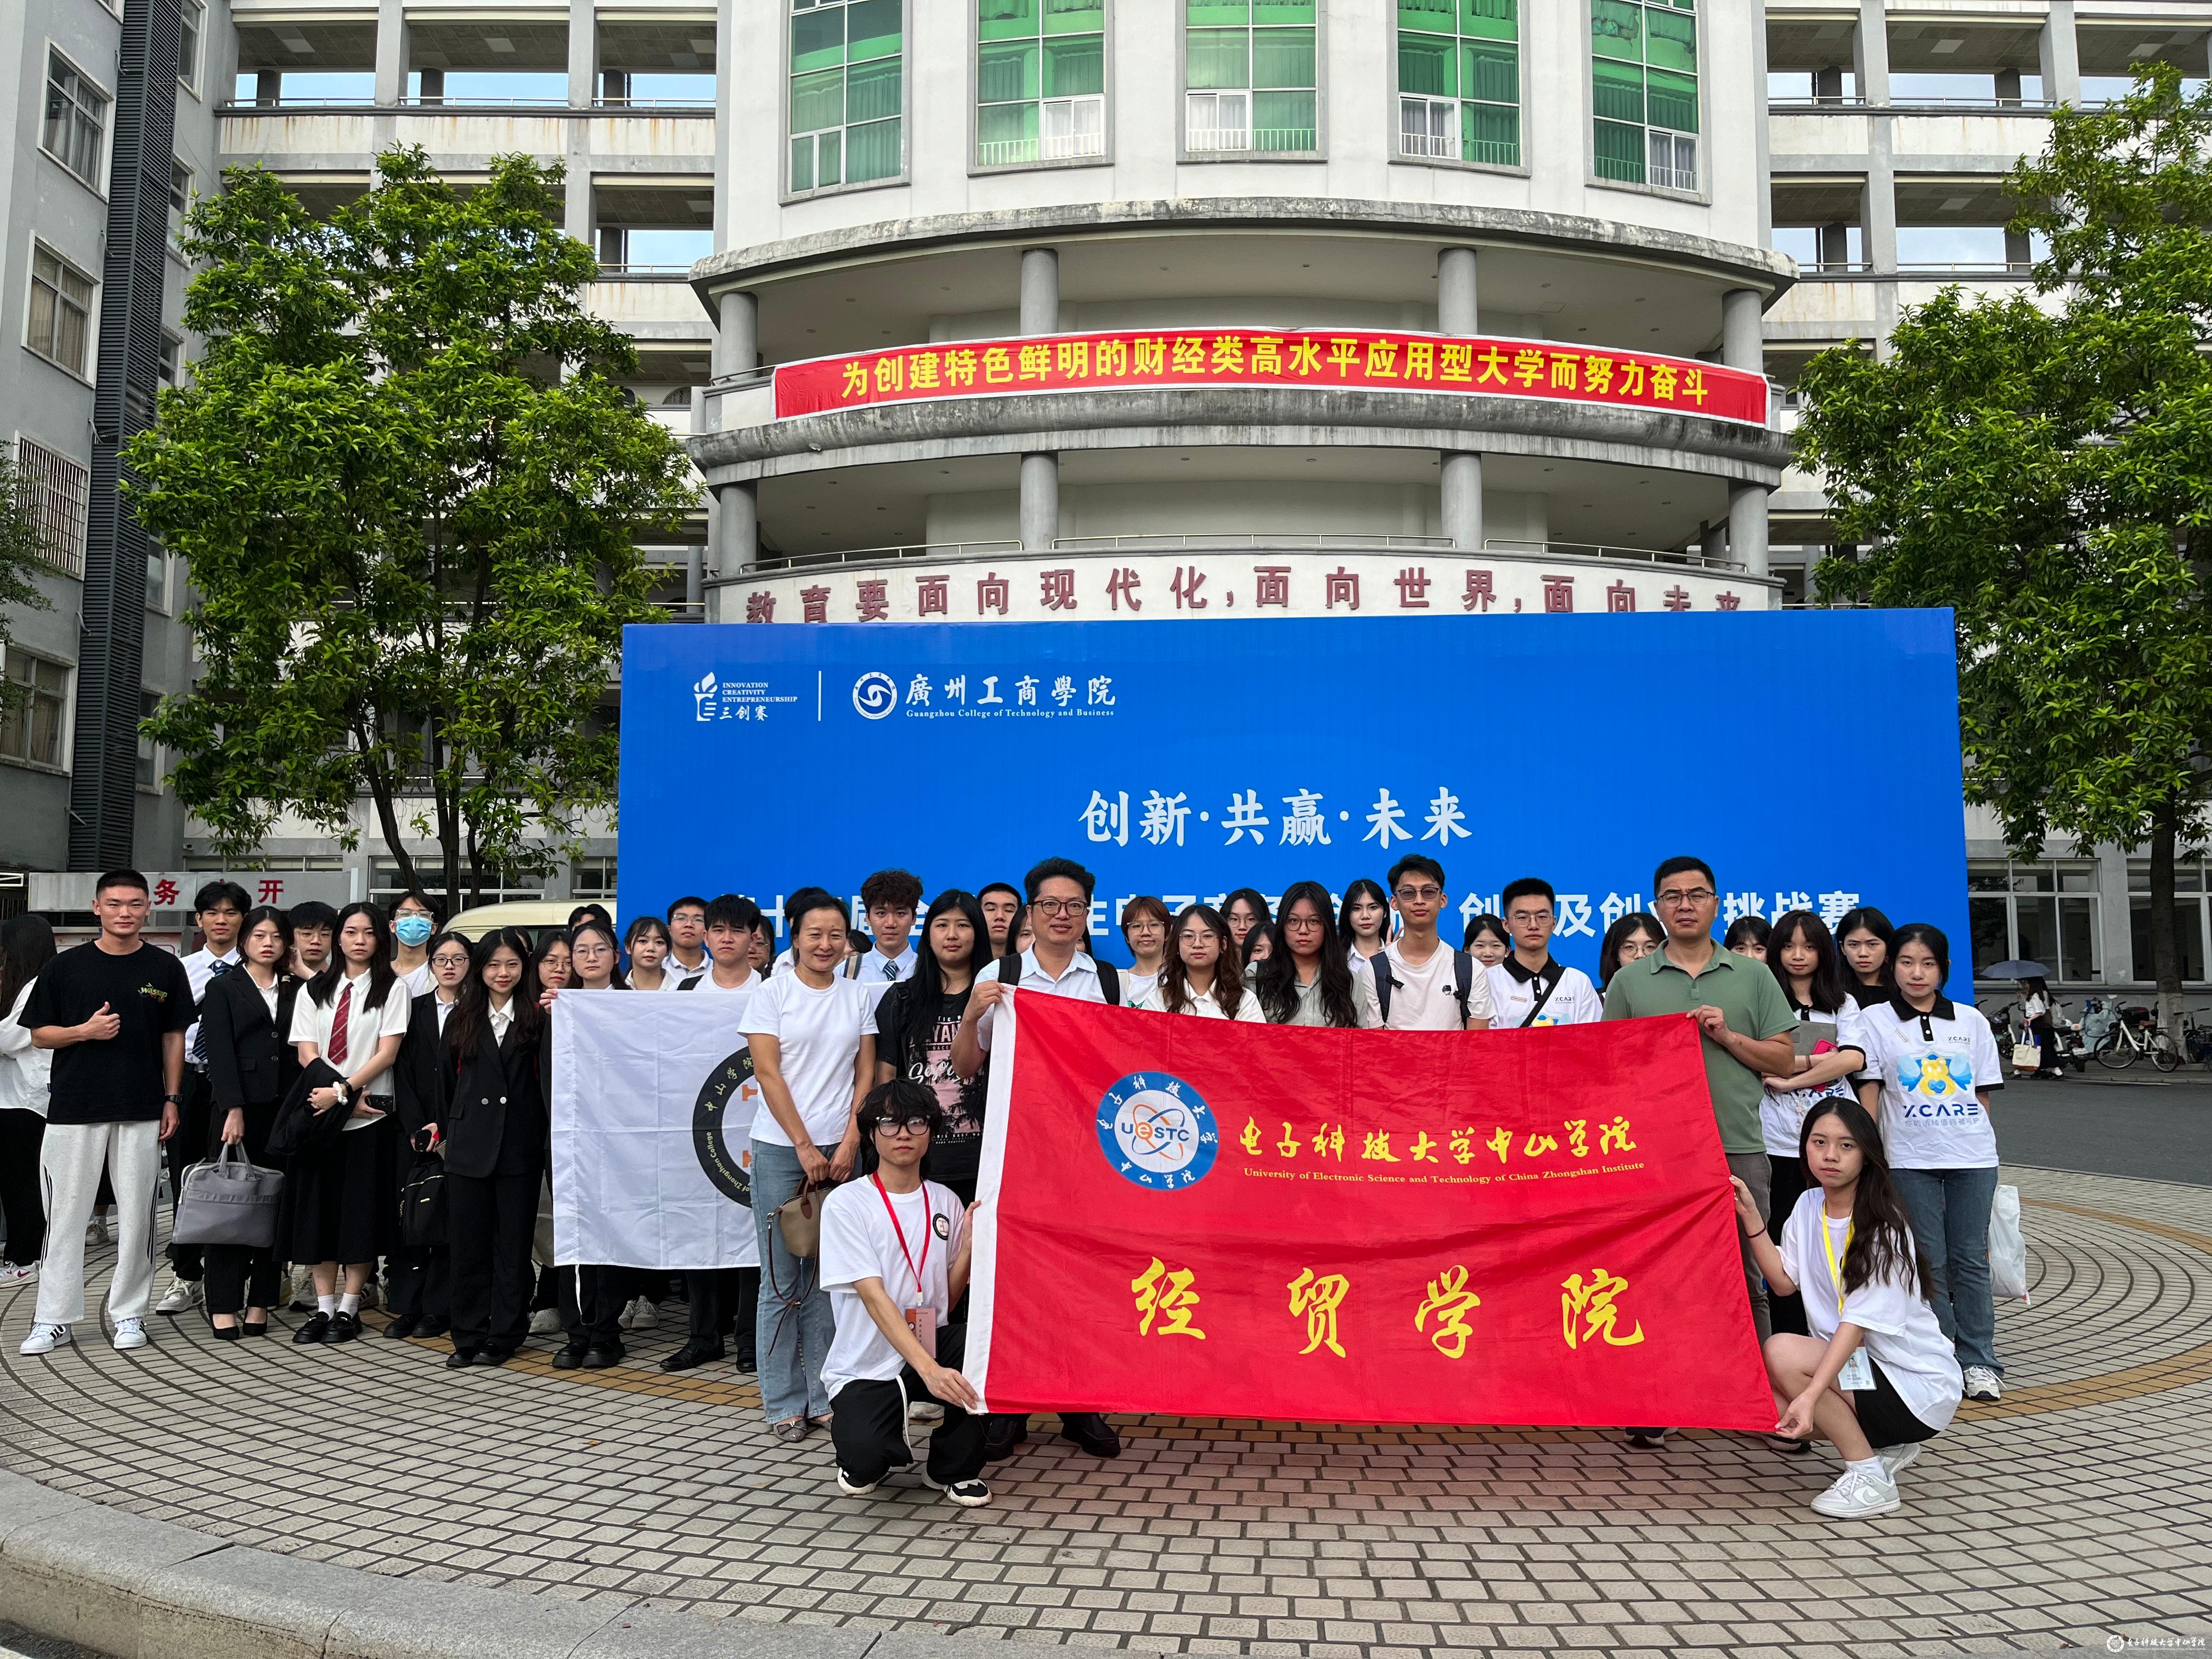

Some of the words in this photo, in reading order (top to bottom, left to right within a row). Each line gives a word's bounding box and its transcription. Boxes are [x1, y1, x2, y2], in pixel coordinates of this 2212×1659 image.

[842, 336, 1708, 406] 为创建特色鲜明的财经类高水平应用型大学而努力奋斗
[906, 673, 1116, 707] 廣州工商學院
[719, 704, 769, 721] 三创赛
[906, 709, 955, 719] Guangzhou
[958, 709, 990, 719] College
[1005, 709, 1055, 719] Technology
[1078, 786, 1472, 849] 创新·共赢·未来
[706, 1131, 717, 1158] College
[1239, 1115, 1637, 1165] 电子科技大学中山学院
[715, 1158, 742, 1189] Zhongshan
[1244, 1167, 1295, 1181] University
[1299, 1171, 1311, 1180] of
[1313, 1172, 1364, 1182] Electronic
[1368, 1175, 1406, 1183] Science
[1431, 1175, 1491, 1184] Technology
[1509, 1173, 1538, 1181] China
[1542, 1166, 1599, 1179] Zhongshan
[1602, 1161, 1644, 1173] Institute
[1130, 1256, 1645, 1359] 经贸学院
